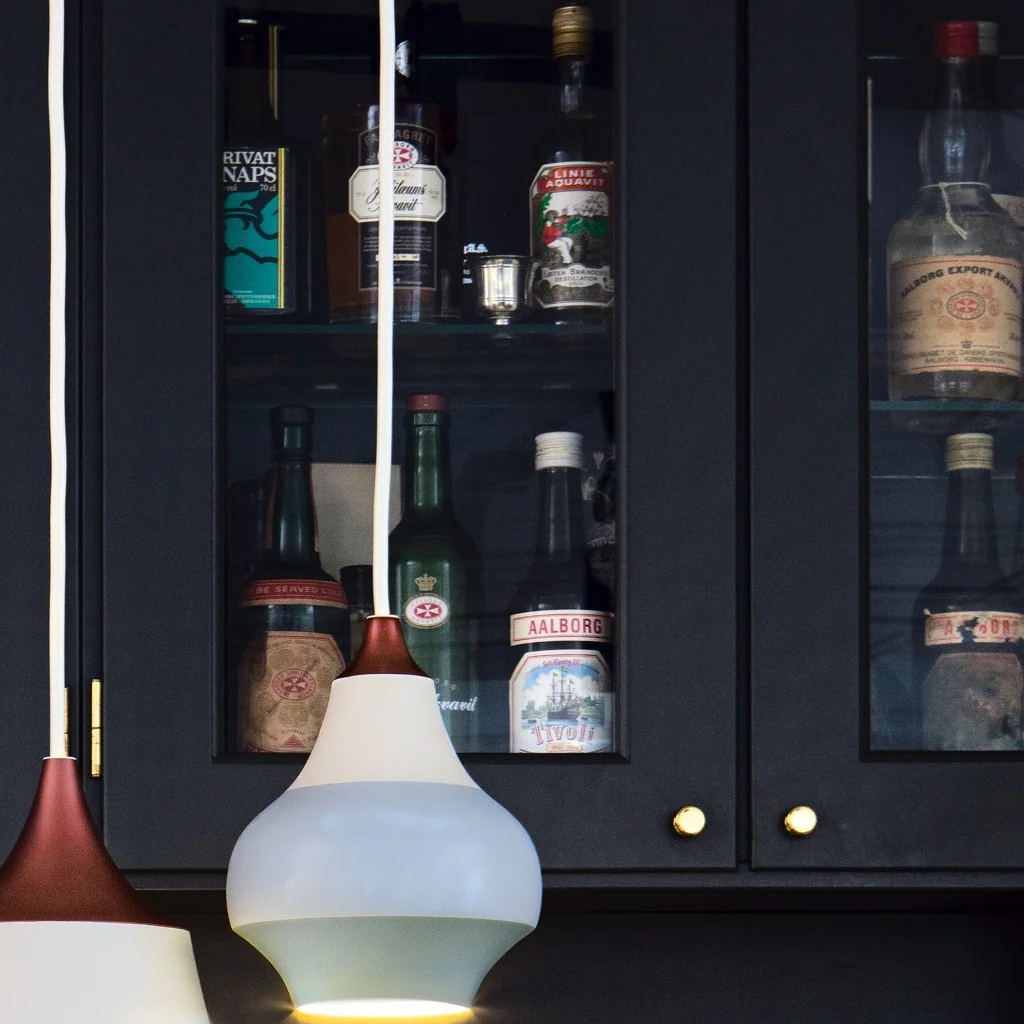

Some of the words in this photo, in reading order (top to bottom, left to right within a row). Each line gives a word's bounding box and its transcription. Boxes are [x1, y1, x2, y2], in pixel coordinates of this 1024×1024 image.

[223, 151, 276, 164] RIVAT
[223, 166, 277, 183] NAPS
[554, 169, 595, 179] LINIE
[545, 178, 604, 188] AQUAVIT
[947, 265, 994, 277] EXPORT
[256, 586, 270, 594] BE
[528, 617, 603, 636] AALBORG
[530, 722, 596, 746] Tivoli
